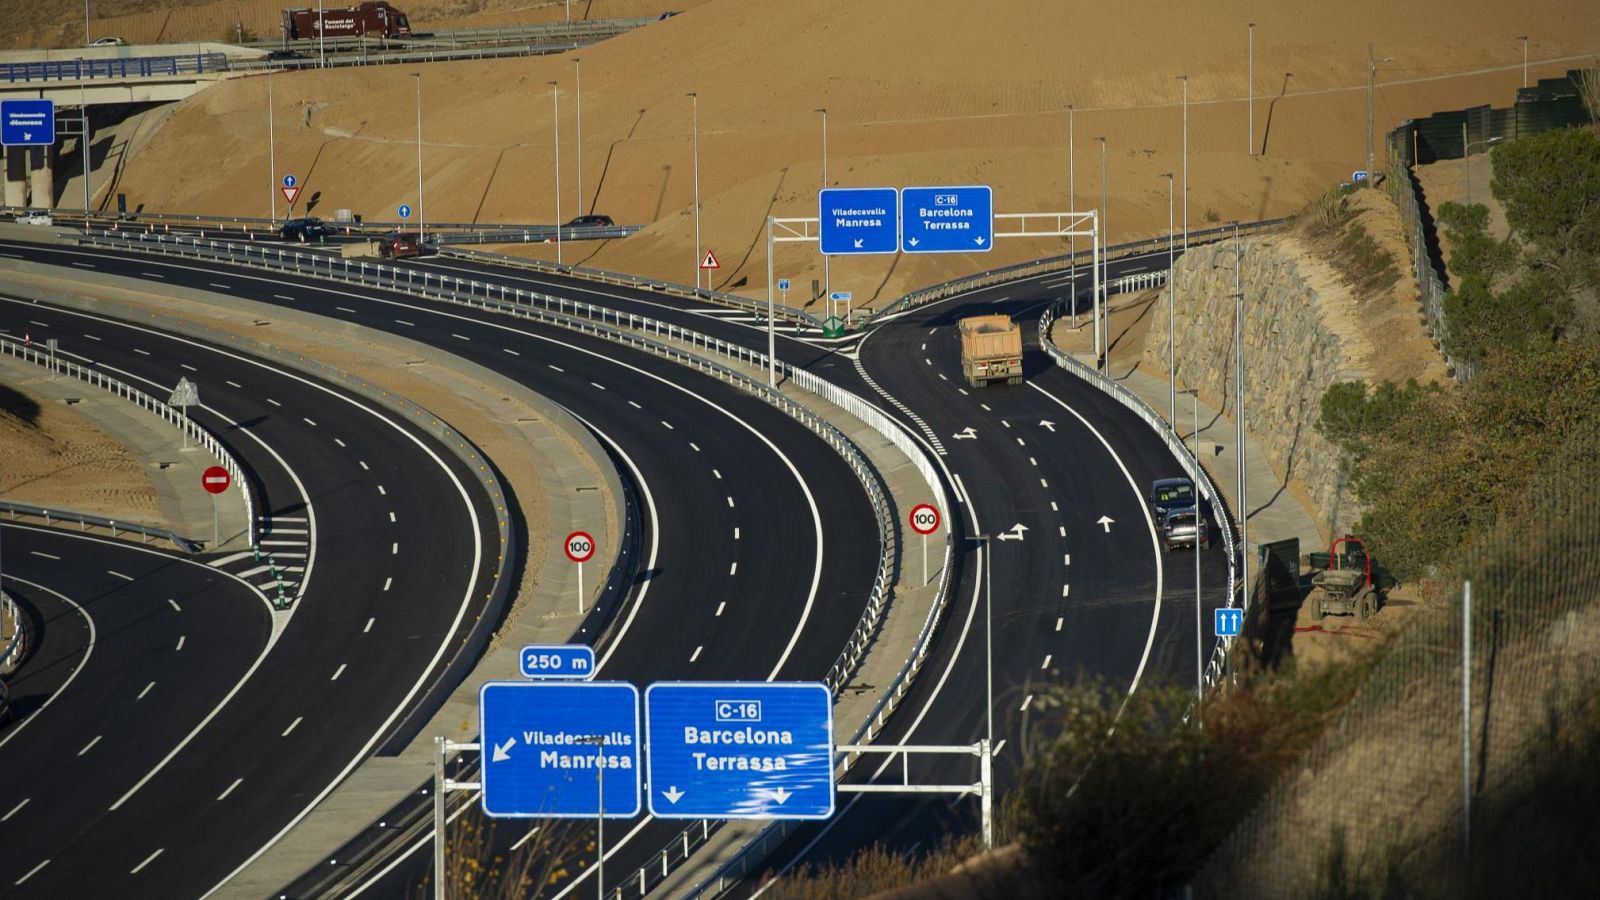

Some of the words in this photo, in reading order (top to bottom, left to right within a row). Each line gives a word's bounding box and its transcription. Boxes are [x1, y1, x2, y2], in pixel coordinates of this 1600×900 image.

[937, 196, 956, 204] C-16
[831, 208, 886, 216] Viladecavalls
[920, 207, 973, 217] Barcelona
[836, 218, 882, 227] Manresa
[923, 220, 970, 230] Terrassa
[914, 514, 935, 525] 100
[569, 541, 590, 552] 100
[527, 654, 562, 669] 250
[572, 658, 588, 669] m
[719, 703, 758, 718] C-16
[684, 726, 793, 744] Barcelona
[540, 751, 633, 769] Manresa
[692, 752, 787, 770] Terrassa
